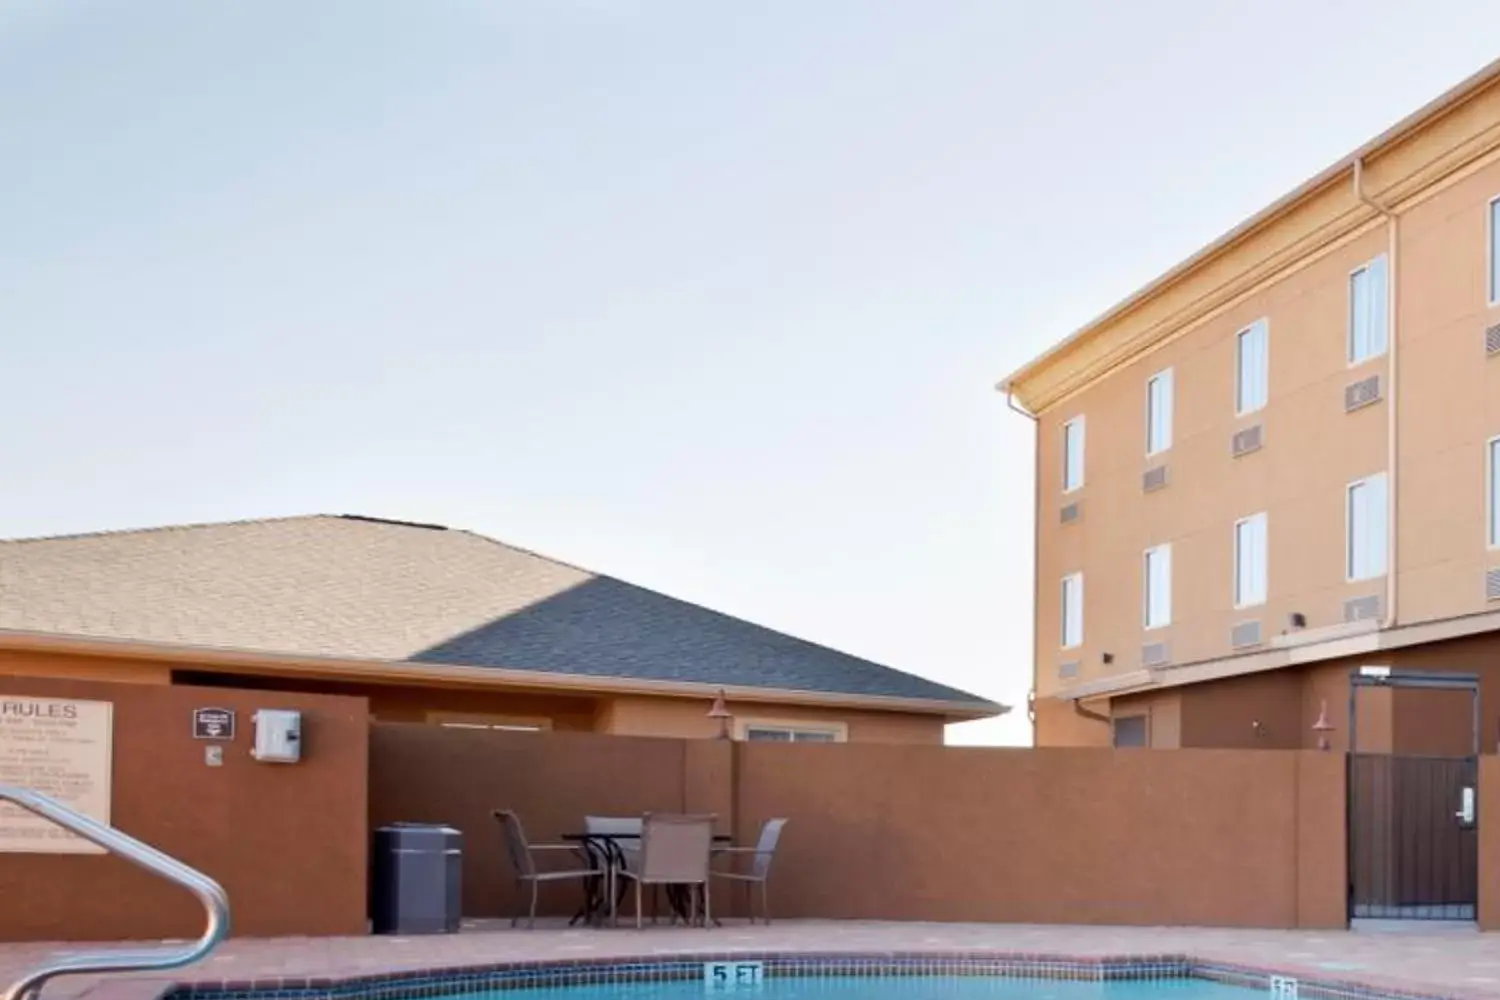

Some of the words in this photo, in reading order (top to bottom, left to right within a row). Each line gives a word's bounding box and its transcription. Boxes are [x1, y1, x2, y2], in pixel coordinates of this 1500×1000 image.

[2, 702, 78, 718] RULES
[713, 965, 728, 982] 5
[736, 965, 759, 985] FT
